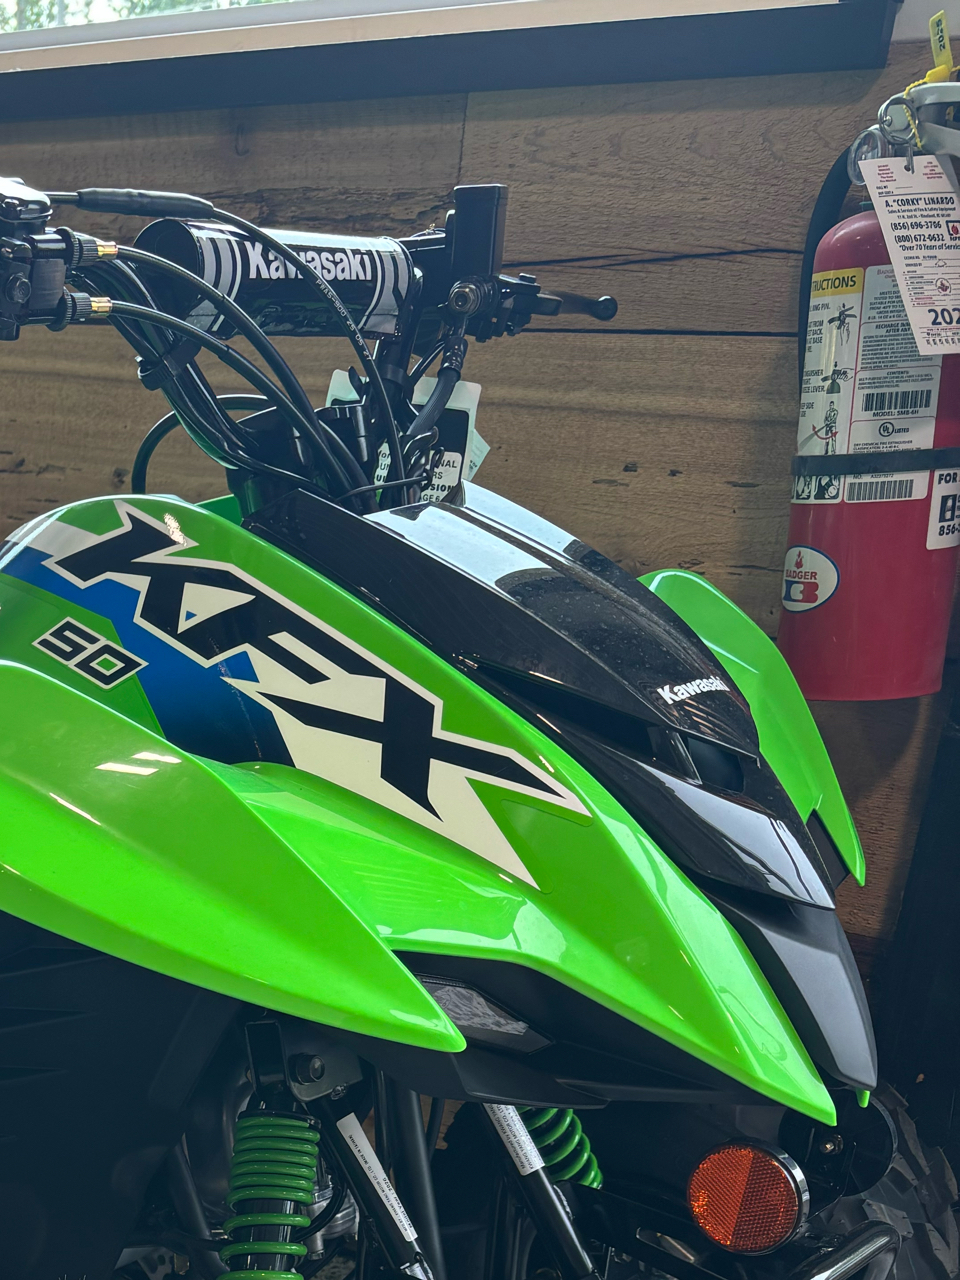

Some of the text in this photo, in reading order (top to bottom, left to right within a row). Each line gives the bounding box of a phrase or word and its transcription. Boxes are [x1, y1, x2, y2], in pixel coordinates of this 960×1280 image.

[891, 222, 910, 232] (856)
[894, 234, 913, 244] (800)
[923, 243, 937, 251] Years
[938, 472, 958, 485] FOR
[34, 617, 148, 689] 50
[46, 502, 582, 832] KFX
[657, 676, 731, 705] Kawasaki
